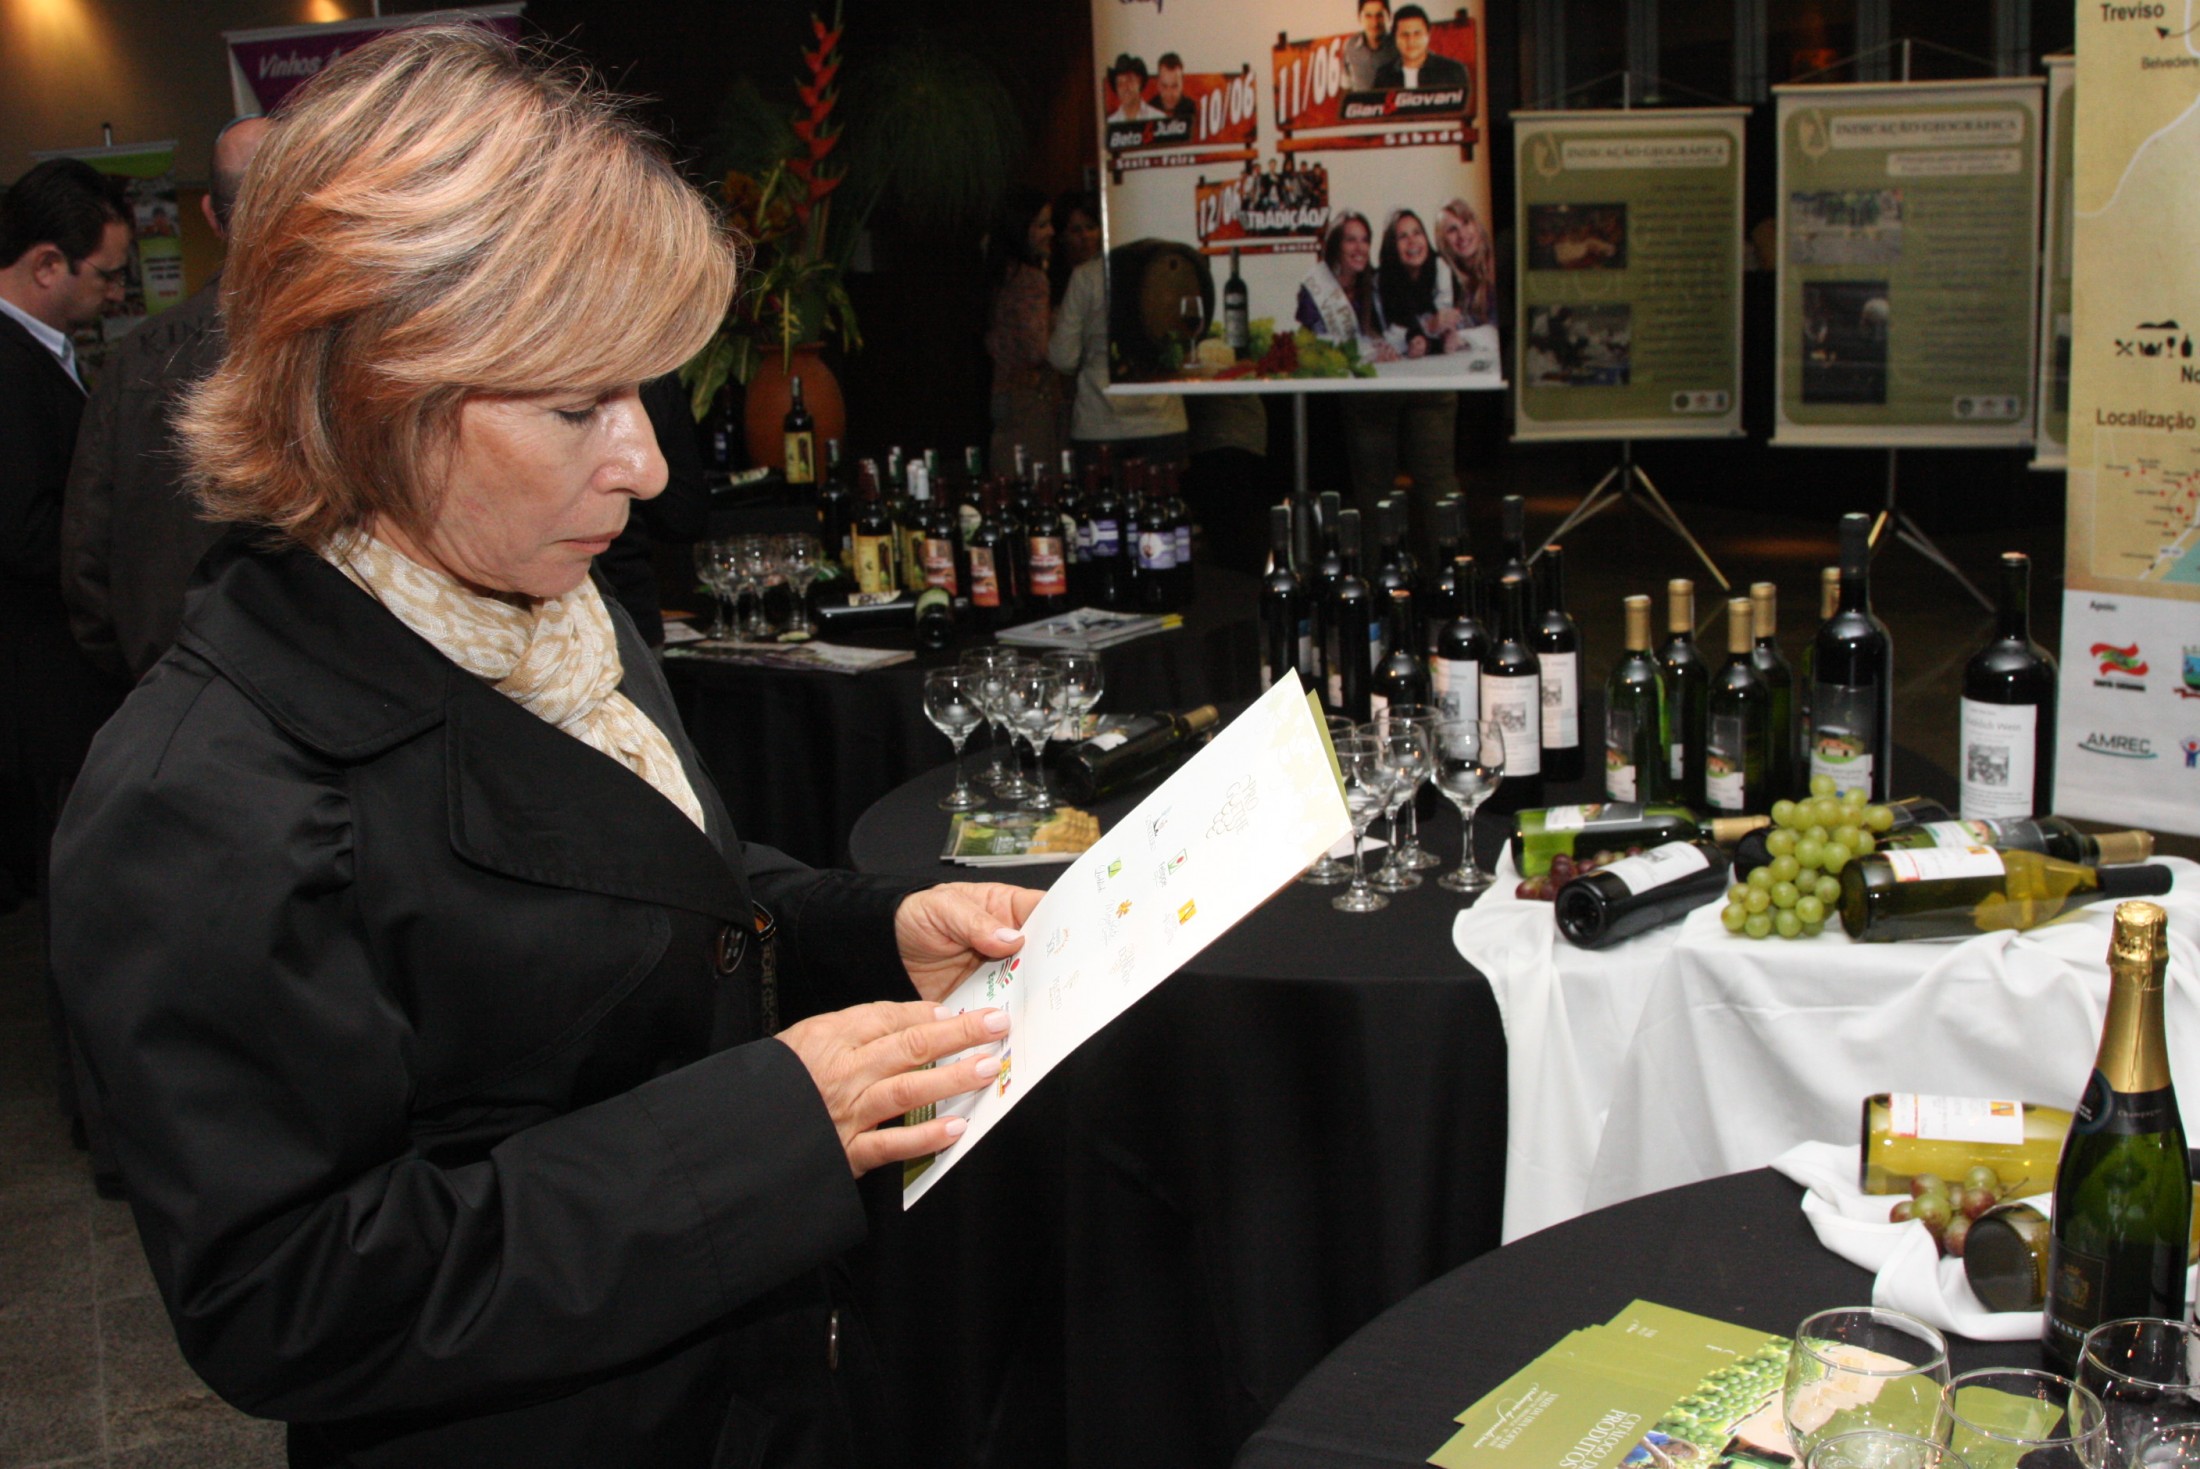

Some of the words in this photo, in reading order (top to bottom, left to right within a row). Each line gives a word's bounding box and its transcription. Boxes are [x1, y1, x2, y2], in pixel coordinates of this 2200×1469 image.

[2101, 1, 2164, 21] Treviso
[259, 50, 322, 79] Vinhos
[1278, 37, 1341, 124] 11/06
[1200, 71, 1255, 140] 10/06
[1110, 131, 1142, 148] Beto
[1201, 180, 1241, 237] 12/06
[2097, 409, 2196, 432] Localização
[2087, 732, 2151, 754] AMREC
[1559, 1408, 1628, 1469] PRODUTOS
[1592, 1413, 1642, 1459] CATÁLOGO
